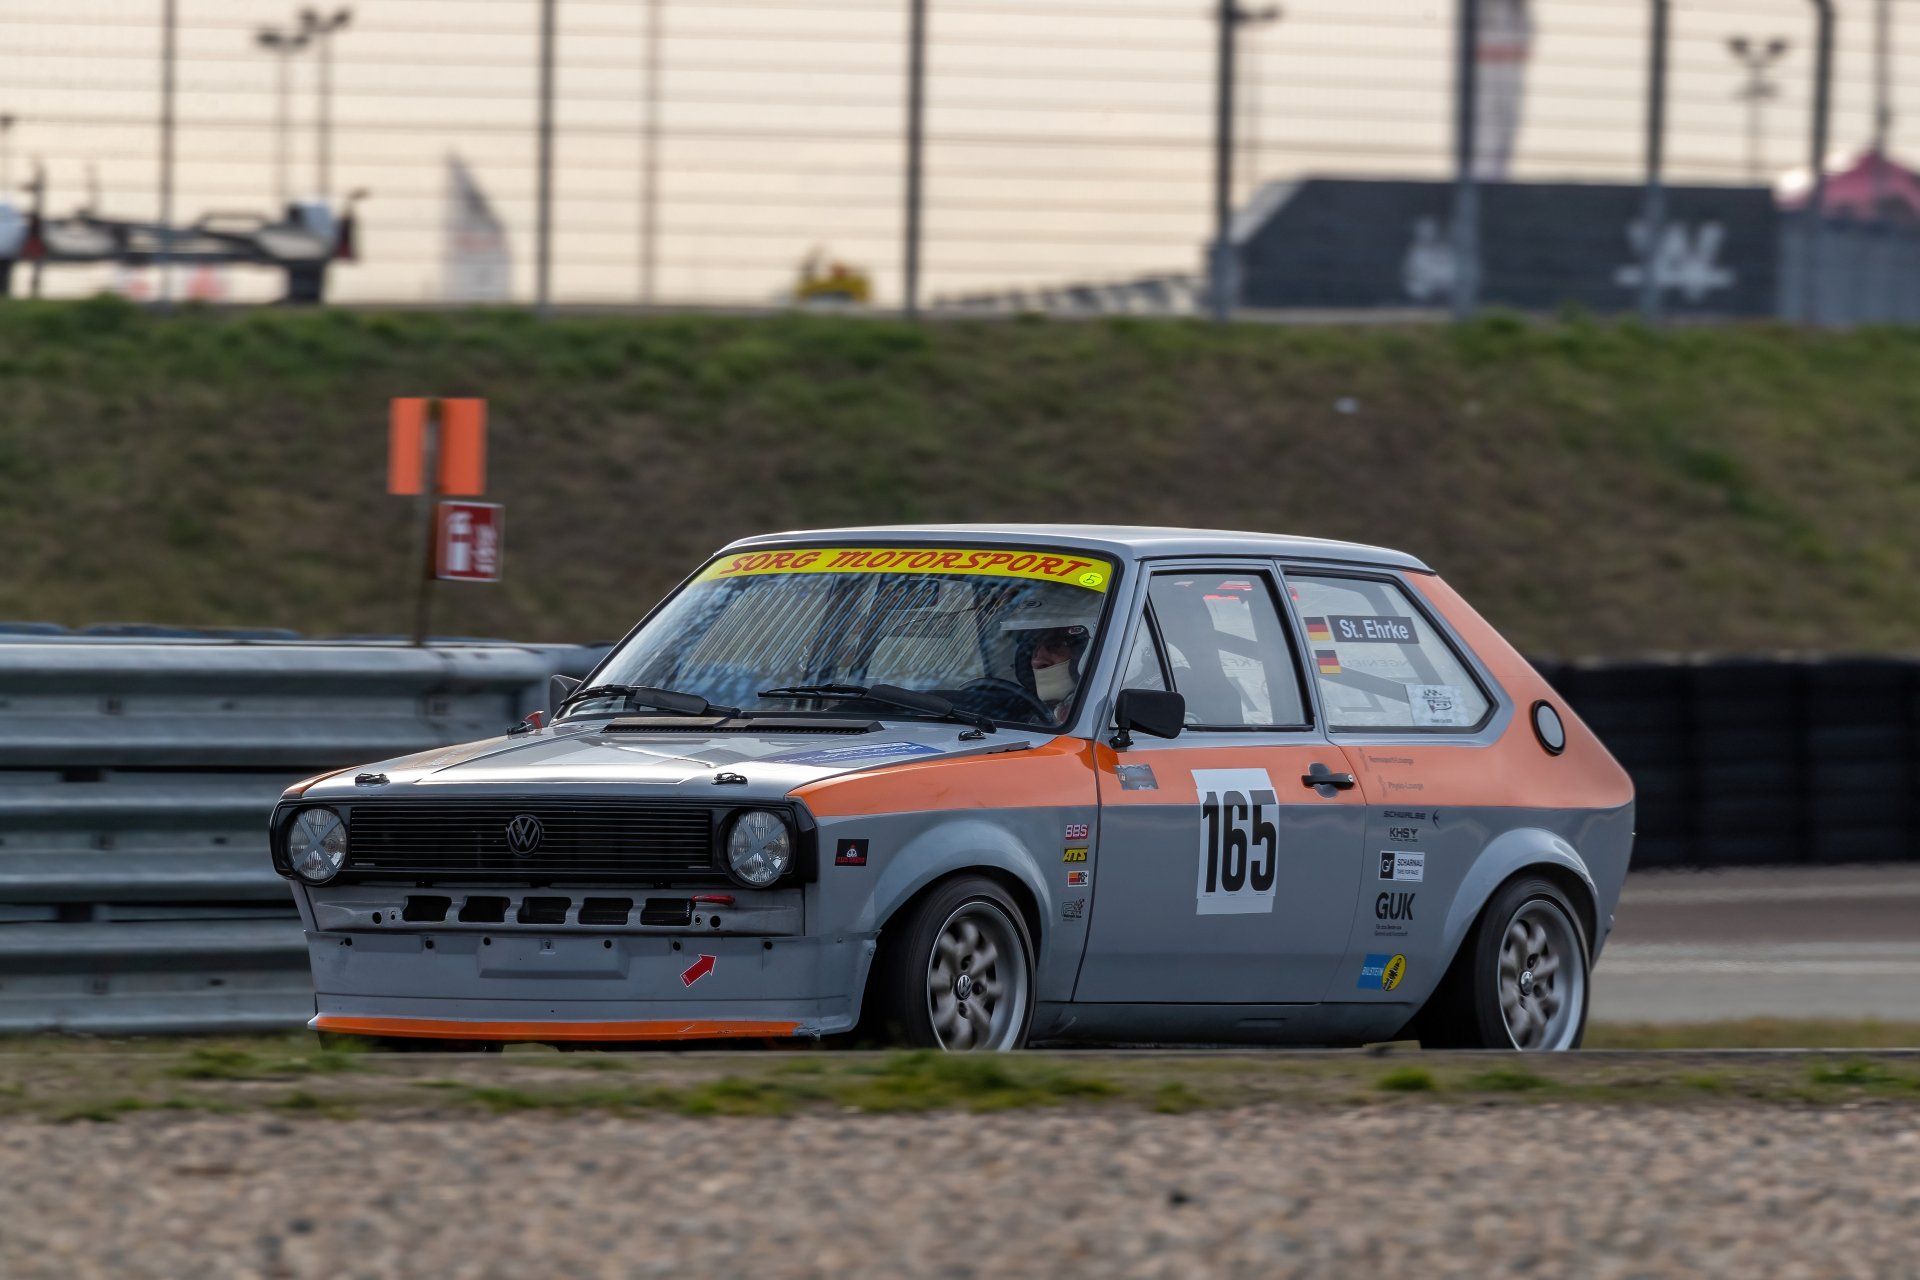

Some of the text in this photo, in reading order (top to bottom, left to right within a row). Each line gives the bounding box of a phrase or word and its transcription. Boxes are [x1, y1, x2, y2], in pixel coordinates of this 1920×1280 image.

[719, 550, 1092, 577] SORG MOTORSPORT
[1339, 618, 1409, 640] St. Ehrke
[1065, 824, 1088, 839] BBS
[1202, 789, 1277, 893] 165
[1062, 848, 1089, 863] ATS
[1375, 891, 1416, 921] GUK
